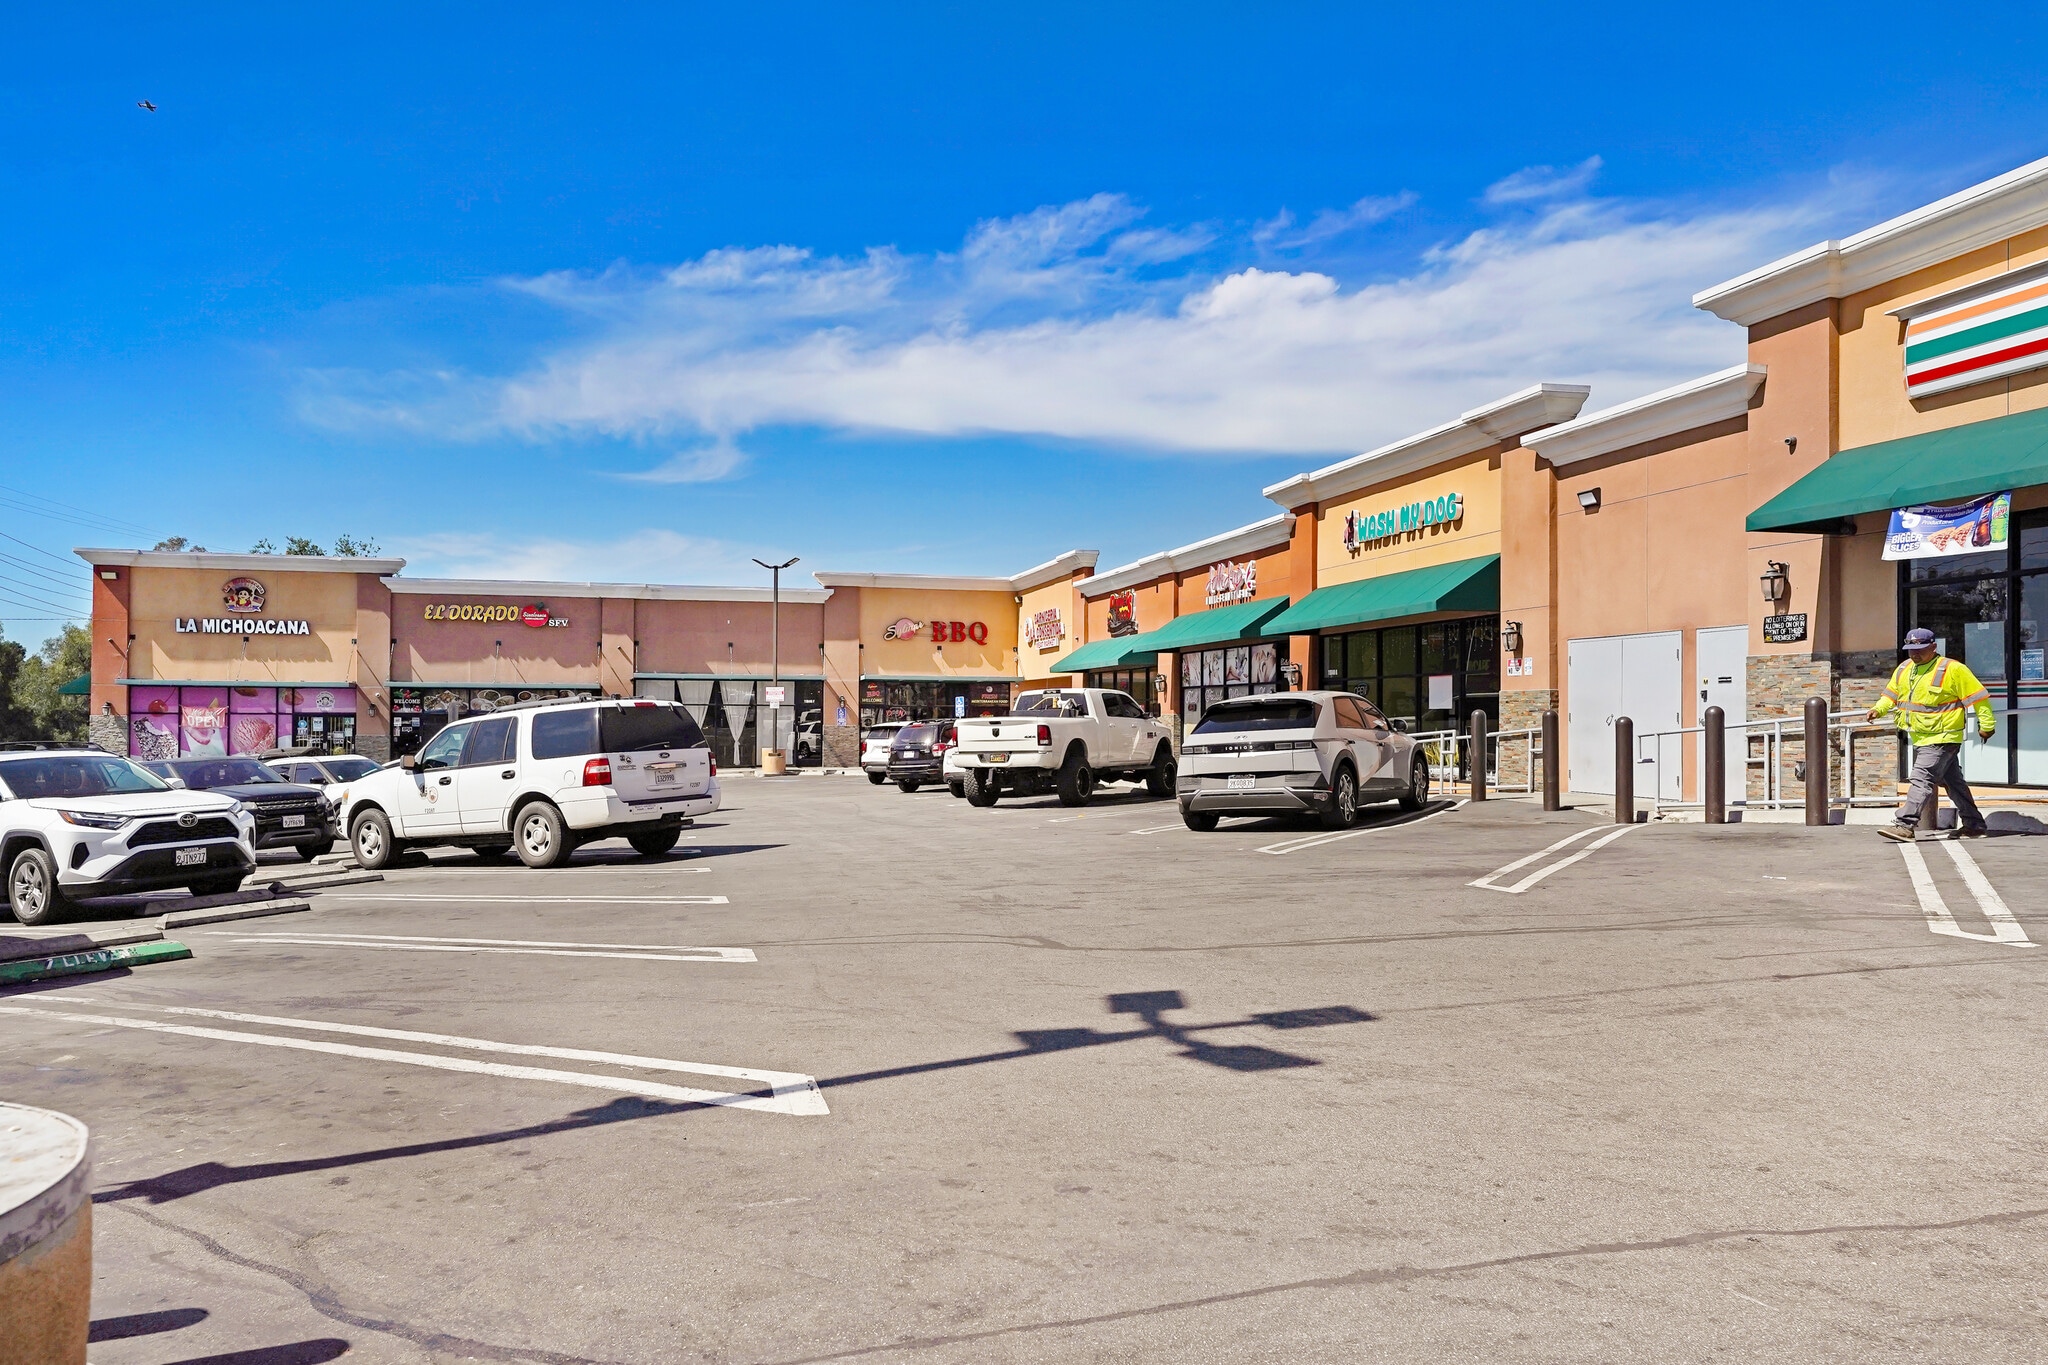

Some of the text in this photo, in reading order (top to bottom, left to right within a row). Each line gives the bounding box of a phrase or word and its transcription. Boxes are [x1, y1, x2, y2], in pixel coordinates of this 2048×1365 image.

[1358, 492, 1458, 543] WASH MY DOG
[1891, 533, 1922, 545] BIGGER
[1889, 543, 1920, 553] SLICES
[424, 604, 519, 623] EL DORADO
[1772, 614, 1799, 623] LOITERING
[175, 618, 310, 635] LA MICHOACANA
[548, 619, 568, 627] SFV
[930, 621, 989, 646] BBQ
[187, 715, 220, 727] OPEN
